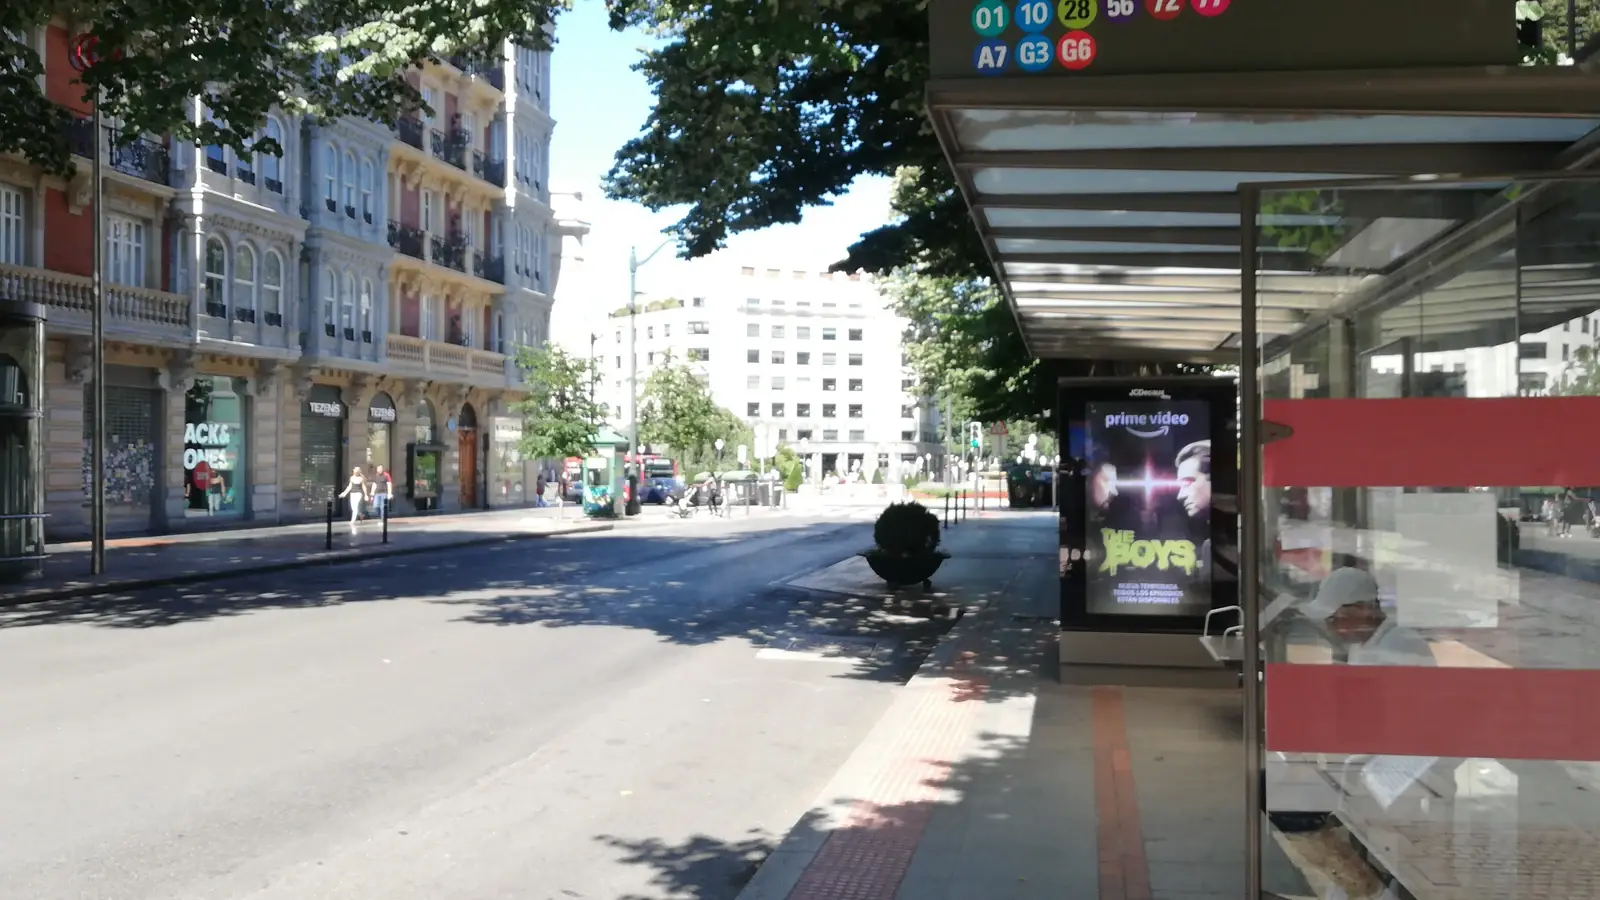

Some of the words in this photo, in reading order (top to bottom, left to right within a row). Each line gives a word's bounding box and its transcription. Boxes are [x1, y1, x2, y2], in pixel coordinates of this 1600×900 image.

[975, 6, 1004, 29] 01
[1020, 2, 1048, 25] 10
[1064, 0, 1090, 20] 28
[1107, 0, 1135, 17] 56
[978, 46, 1007, 69] A7
[1020, 42, 1049, 65] G3
[1062, 38, 1091, 62] G6
[309, 401, 341, 414] TEZENIS
[1105, 411, 1147, 428] prime
[1150, 411, 1189, 425] video
[1100, 527, 1135, 543] THE
